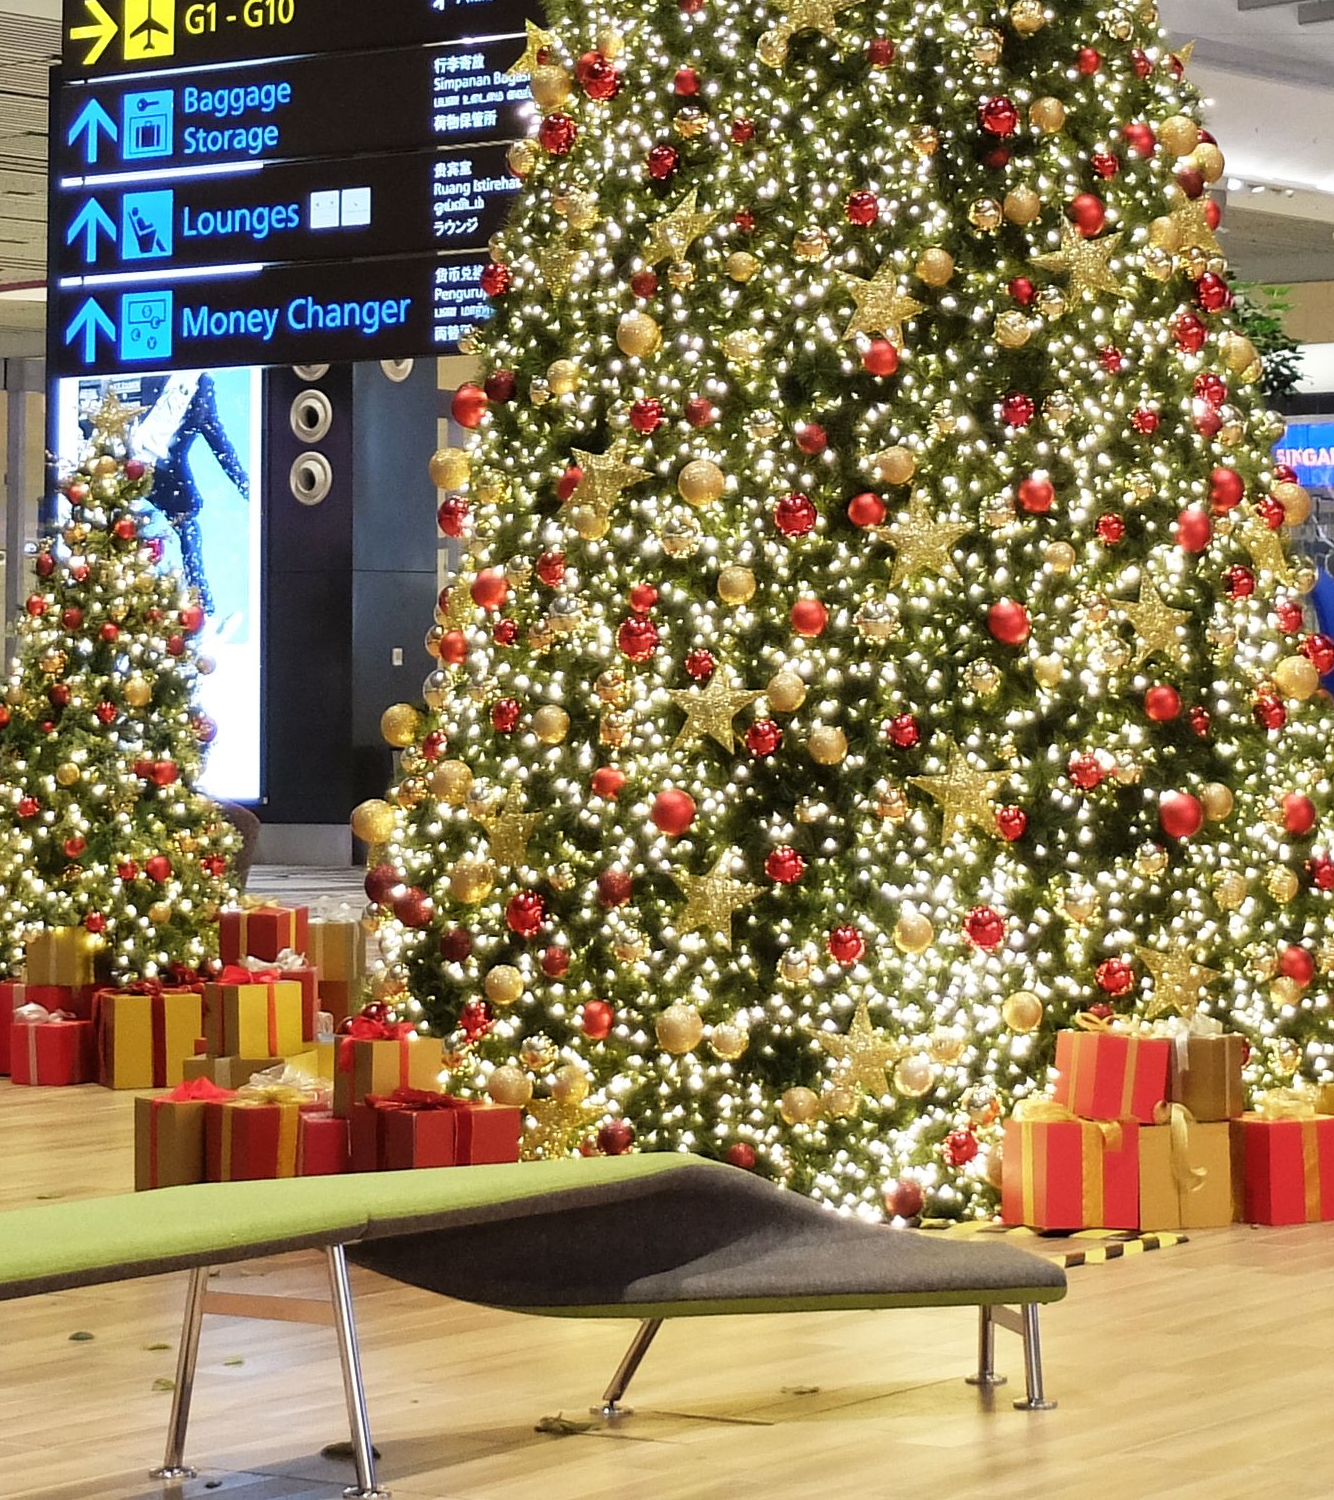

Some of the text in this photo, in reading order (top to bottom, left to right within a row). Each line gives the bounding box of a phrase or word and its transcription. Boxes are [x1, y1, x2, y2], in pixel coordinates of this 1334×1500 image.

[184, 2, 217, 35] G1
[183, 81, 292, 117] Baggage
[433, 74, 491, 93] Simpanan
[183, 124, 279, 155] Storage
[433, 183, 471, 197] Ruang
[183, 202, 300, 239] Lounges
[433, 217, 479, 237] ラウンジ
[182, 305, 279, 341] Money
[287, 296, 412, 334] Changer
